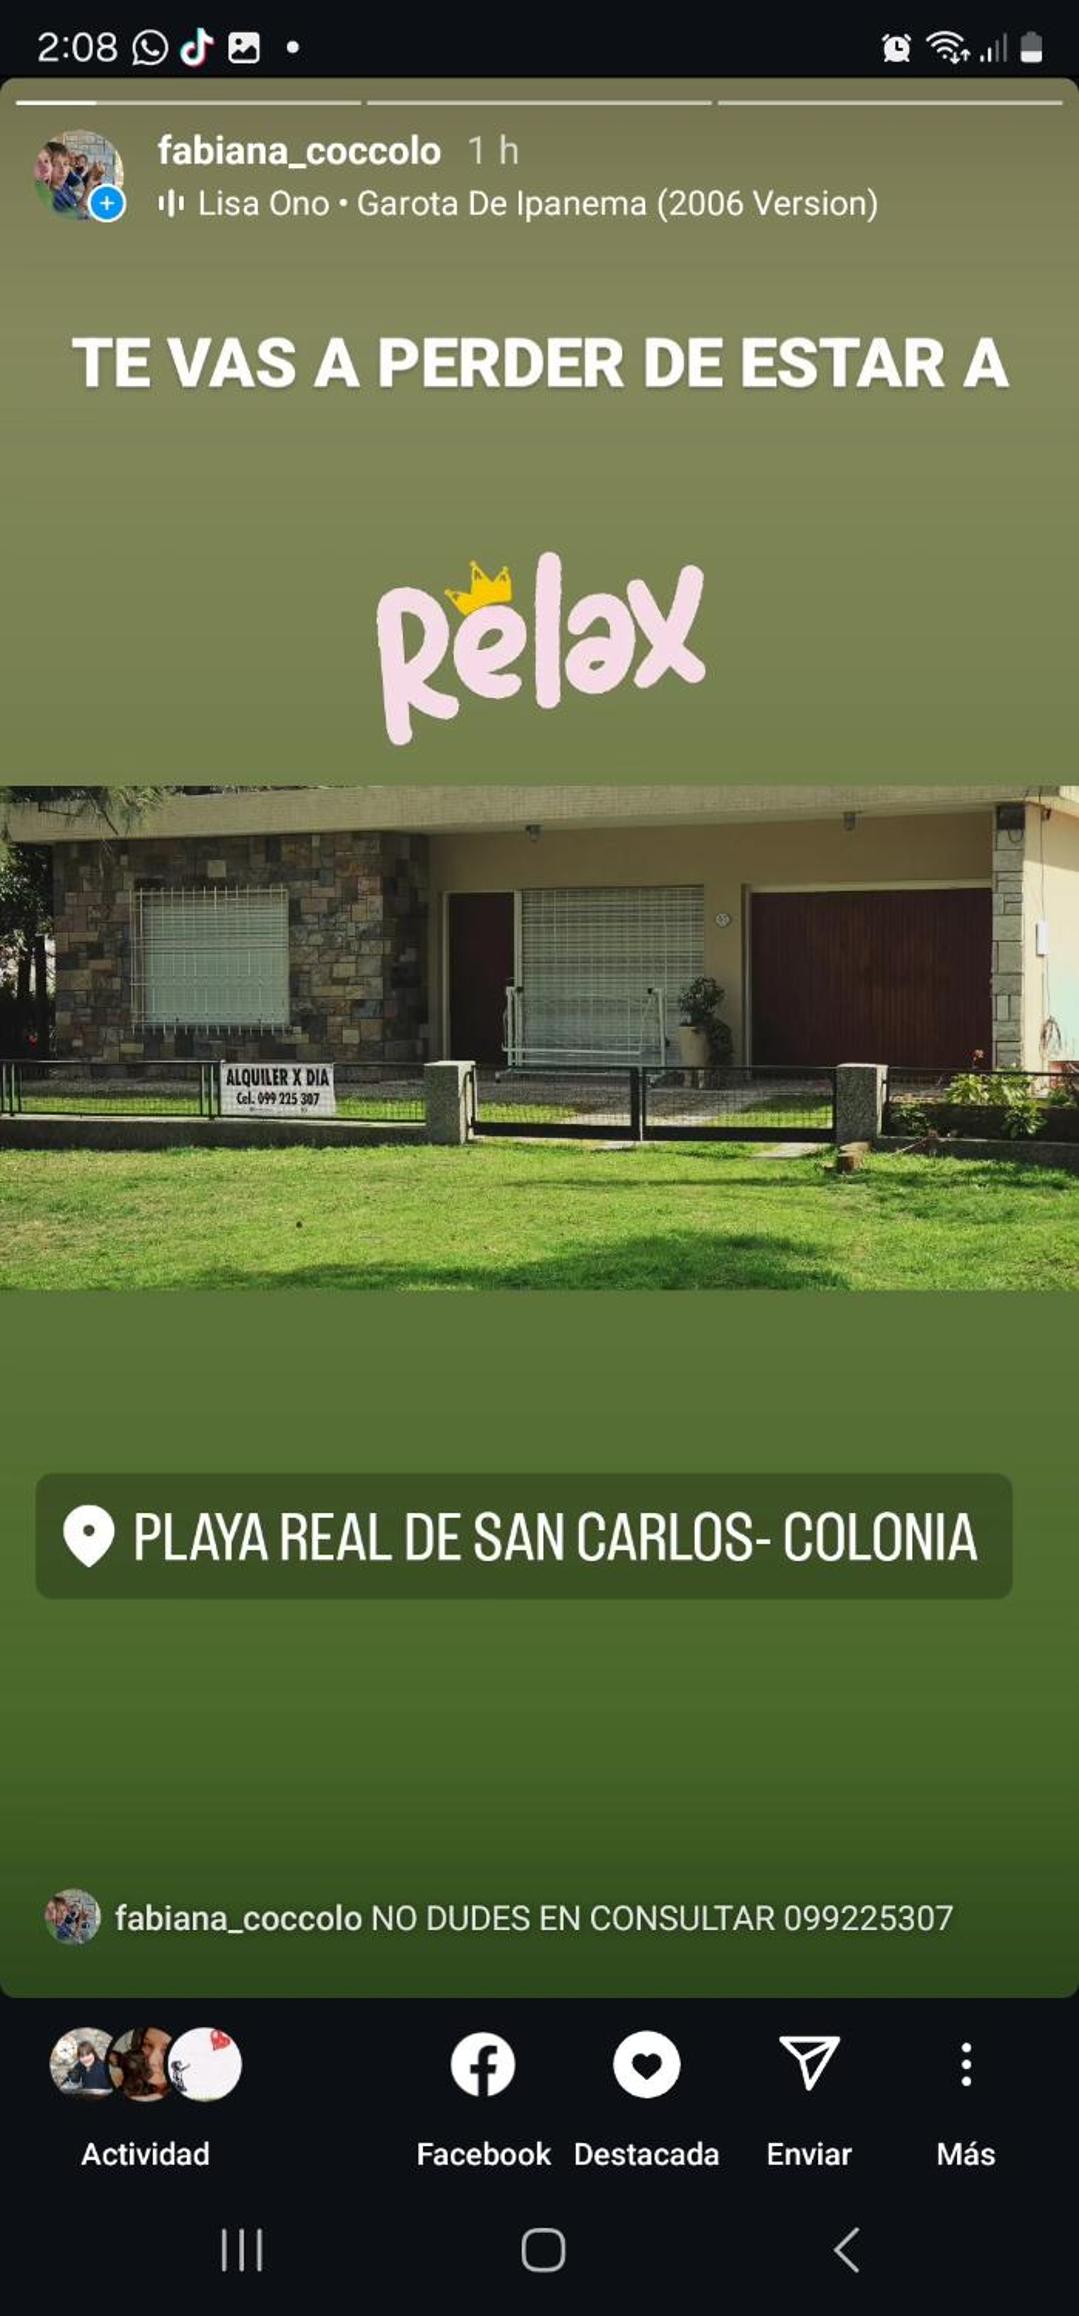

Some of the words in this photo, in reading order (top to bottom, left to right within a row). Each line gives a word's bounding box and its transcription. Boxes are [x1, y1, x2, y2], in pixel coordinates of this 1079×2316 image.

[226, 1068, 288, 1087] ALQUILER
[293, 1068, 301, 1086] X
[306, 1068, 329, 1086] DIA
[236, 1091, 255, 1105] Cel.
[258, 1092, 276, 1104] 099
[279, 1092, 298, 1105] 225
[301, 1092, 320, 1106] 307
